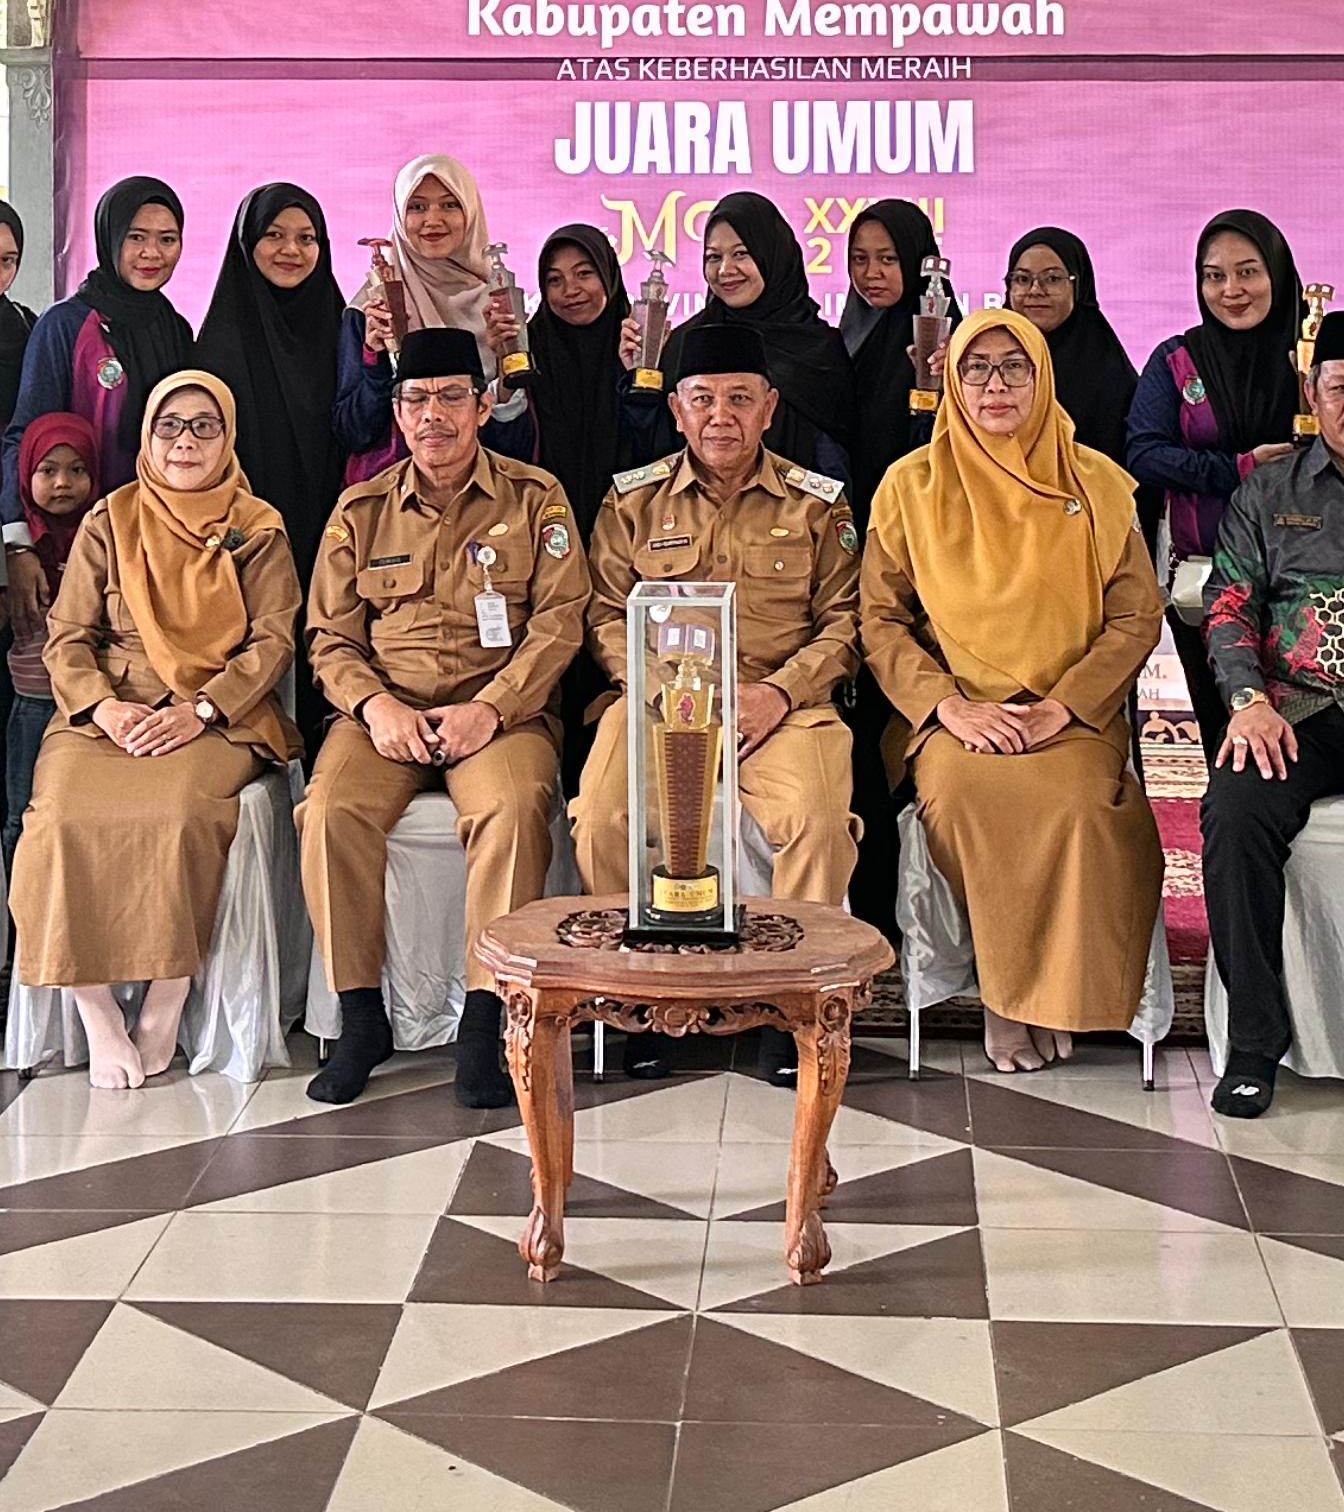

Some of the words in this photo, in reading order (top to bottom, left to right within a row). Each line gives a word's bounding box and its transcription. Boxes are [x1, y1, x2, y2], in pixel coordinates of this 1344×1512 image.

[557, 58, 631, 81] ATAS
[639, 57, 853, 80] KEBERHASILAN
[860, 56, 973, 80] MERAIH
[554, 100, 753, 175] JUARA
[771, 99, 976, 175] UMUM
